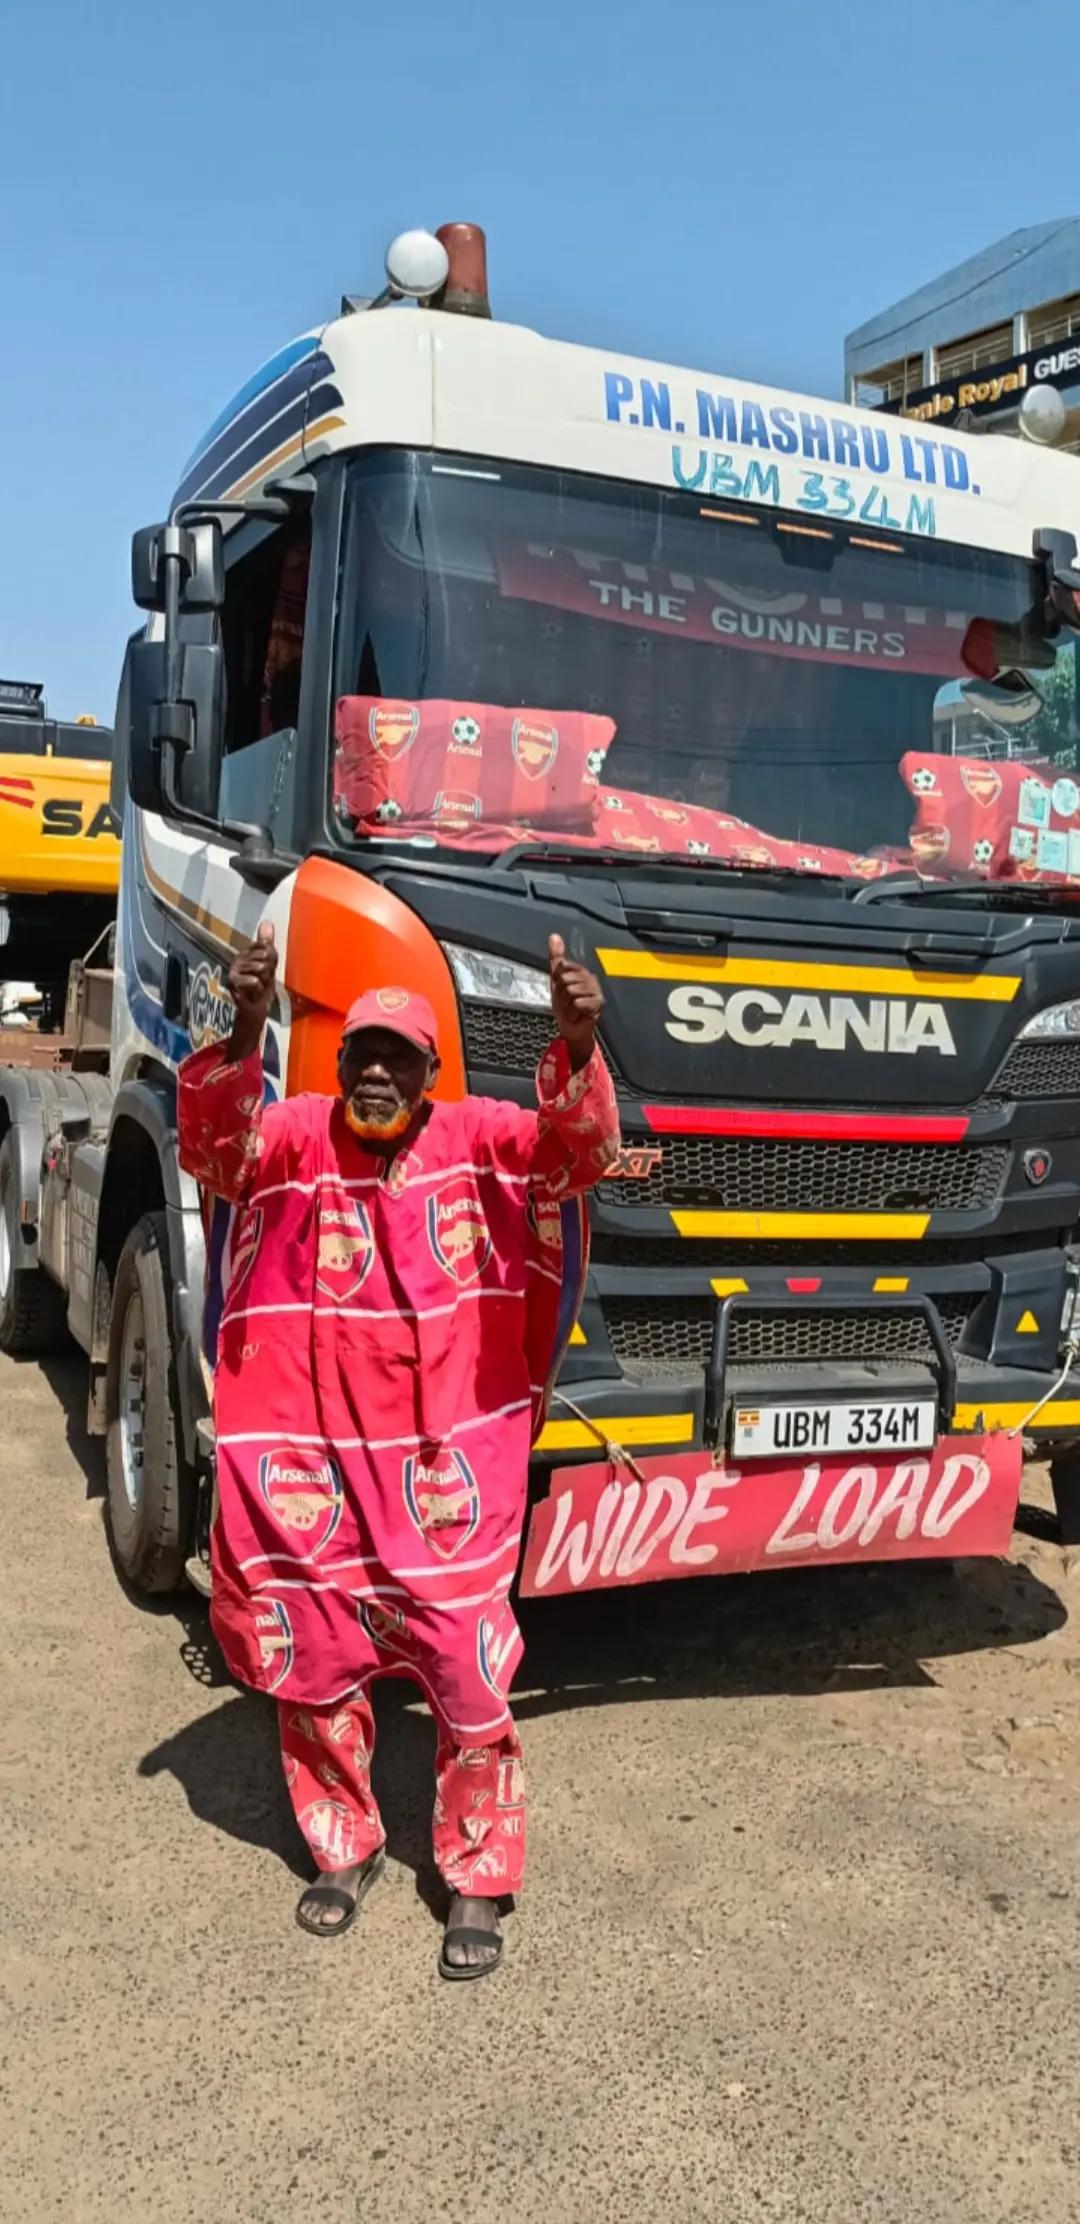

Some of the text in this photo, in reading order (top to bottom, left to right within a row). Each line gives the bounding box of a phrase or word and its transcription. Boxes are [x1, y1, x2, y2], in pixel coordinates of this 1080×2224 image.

[958, 363, 1028, 408] Royal
[604, 372, 981, 495] P.N. MASHRU LTD.
[672, 446, 936, 537] UBM 334M
[588, 580, 687, 623] THE
[710, 606, 906, 658] GUNNERS
[376, 711, 413, 722] Arsenal
[446, 742, 482, 758] Arsenal
[664, 985, 958, 1056] SCANIA
[602, 1148, 663, 1177] XT
[772, 1406, 920, 1449] UBM 334M
[268, 1463, 329, 1484] Arsenal
[534, 1453, 992, 1590] WIDE LOAD
